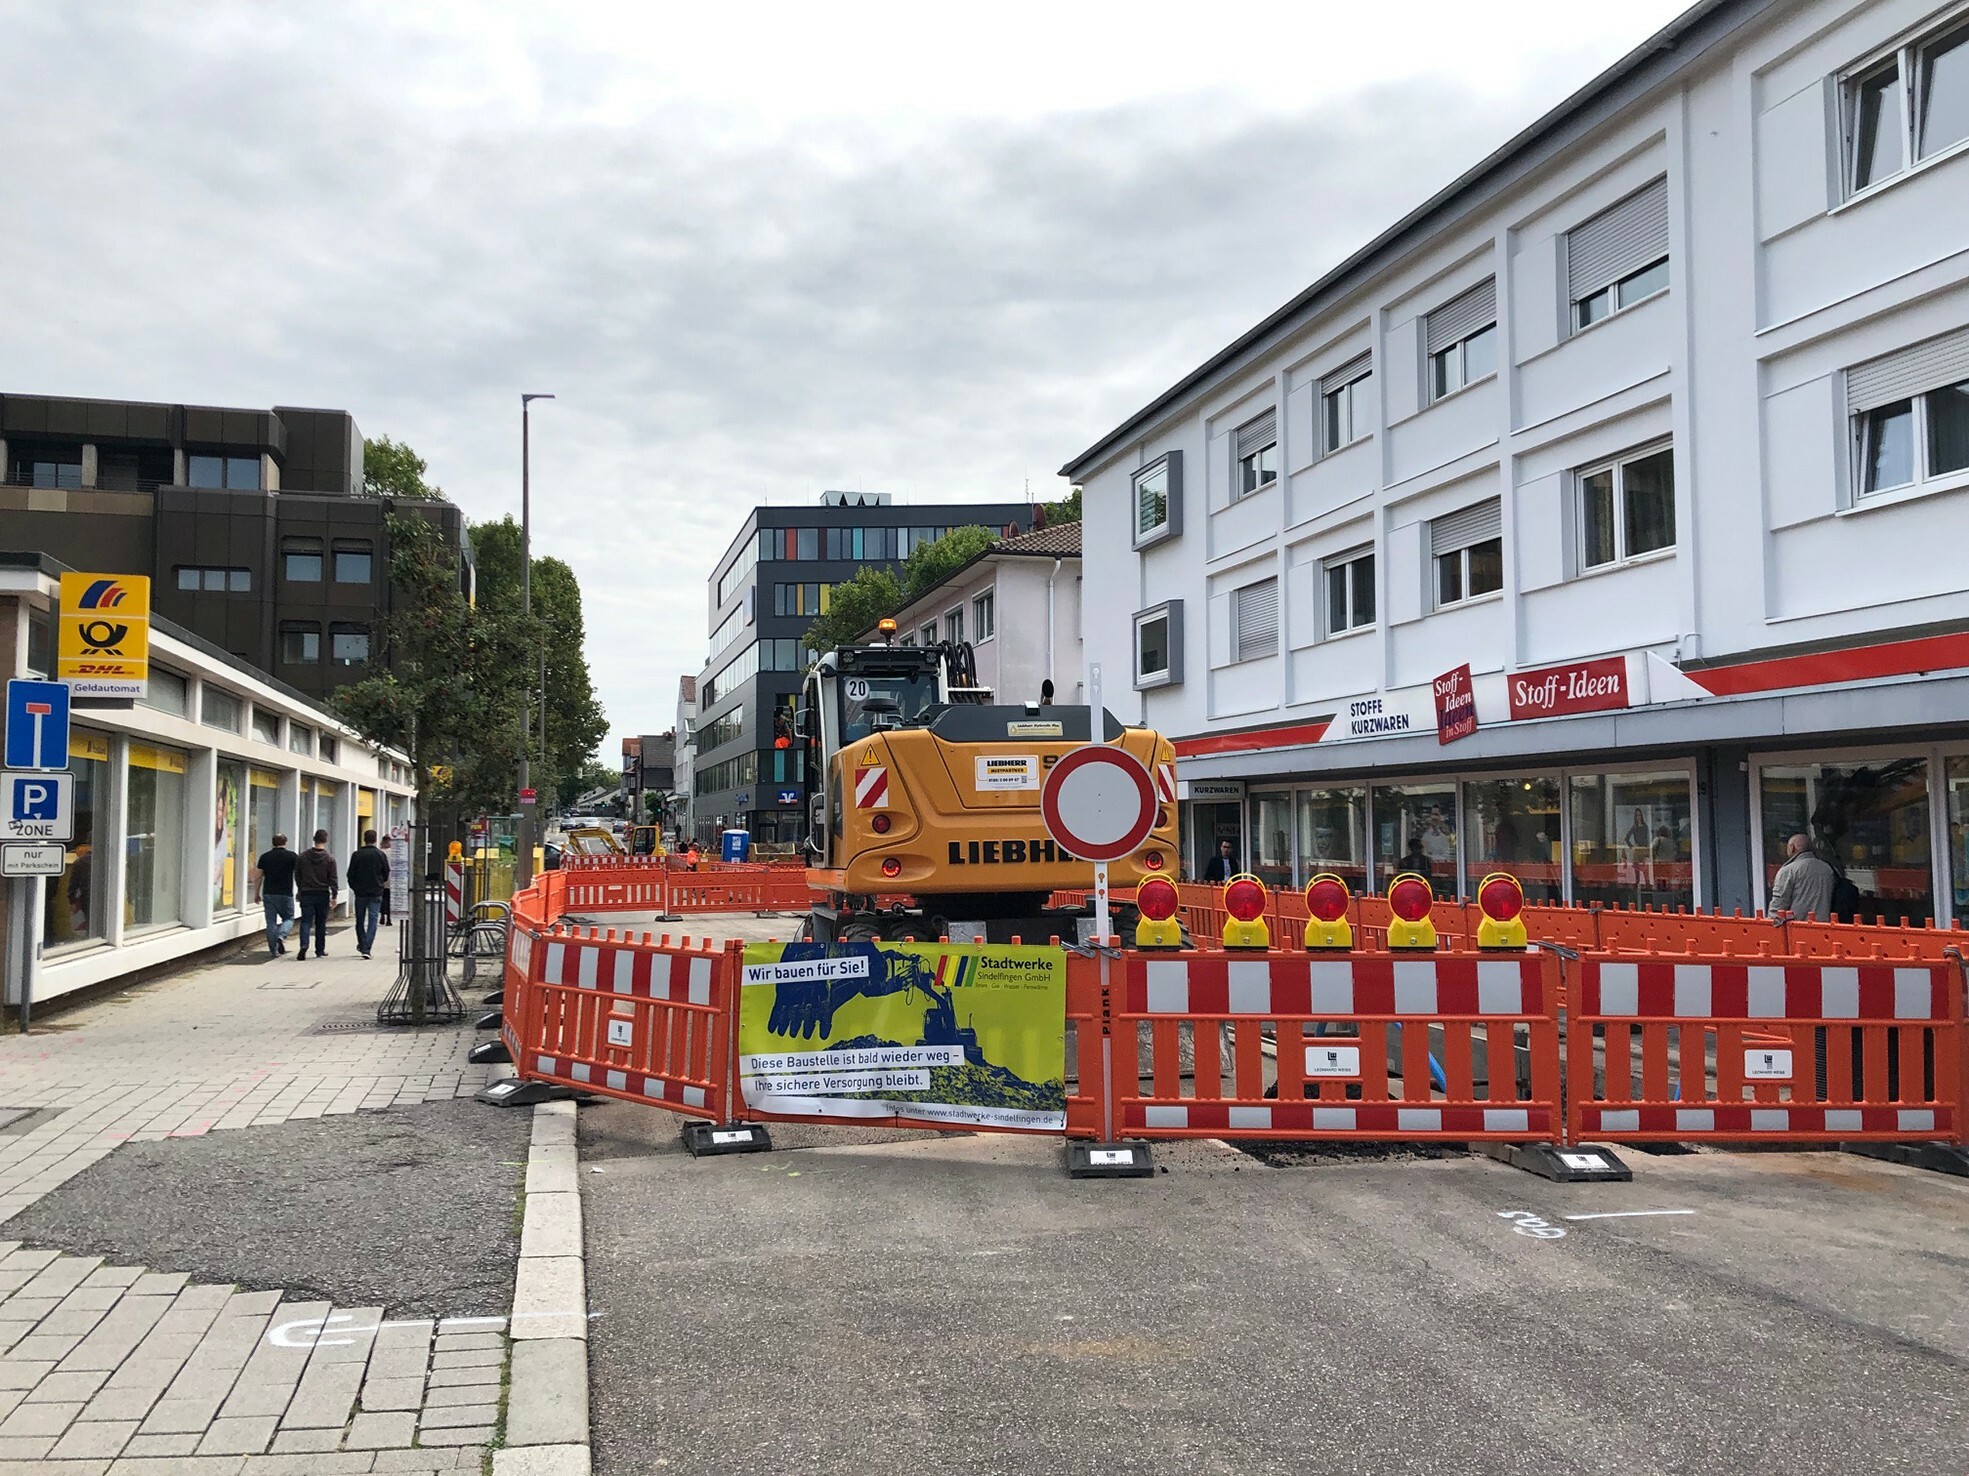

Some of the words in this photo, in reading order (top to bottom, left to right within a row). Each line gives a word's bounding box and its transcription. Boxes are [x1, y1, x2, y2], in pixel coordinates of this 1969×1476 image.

[78, 664, 125, 674] DHL
[75, 683, 140, 693] Geldautomat
[849, 680, 866, 696] 20
[1435, 671, 1464, 697] Stoff-
[1515, 670, 1620, 709] Stoff-Ideen
[1350, 698, 1383, 717] STOFFE
[1445, 691, 1472, 713] Ideen
[1351, 713, 1409, 735] KURZWAREN
[1446, 725, 1454, 739] in
[1454, 715, 1474, 736] Stoff
[23, 784, 48, 815] P
[1194, 786, 1239, 794] KURZWAREN
[16, 824, 53, 836] ZONE
[24, 850, 43, 859] nur
[748, 968, 771, 981] Wir
[775, 966, 814, 979] bauen
[817, 962, 836, 976] für
[839, 960, 864, 975] Sie!
[980, 955, 1053, 971] Stadtwerke
[977, 971, 1023, 983] Sindelfingen
[1024, 972, 1051, 982] GmbH
[1101, 988, 1112, 1035] Plank
[751, 1058, 783, 1070] Diese
[787, 1054, 840, 1068] Baustelle
[842, 1054, 856, 1065] ist
[858, 1052, 878, 1064] bald
[881, 1051, 923, 1063] wieder
[926, 1051, 950, 1064] weg
[755, 1079, 773, 1092] Ihre
[776, 1077, 820, 1091] sichere
[823, 1076, 883, 1091] Versorgung
[886, 1074, 923, 1086] bleibt.
[886, 1103, 904, 1114] Infos
[906, 1107, 926, 1116] unter
[927, 1109, 1053, 1125] www.stadtwerke-sindelfingen.de
